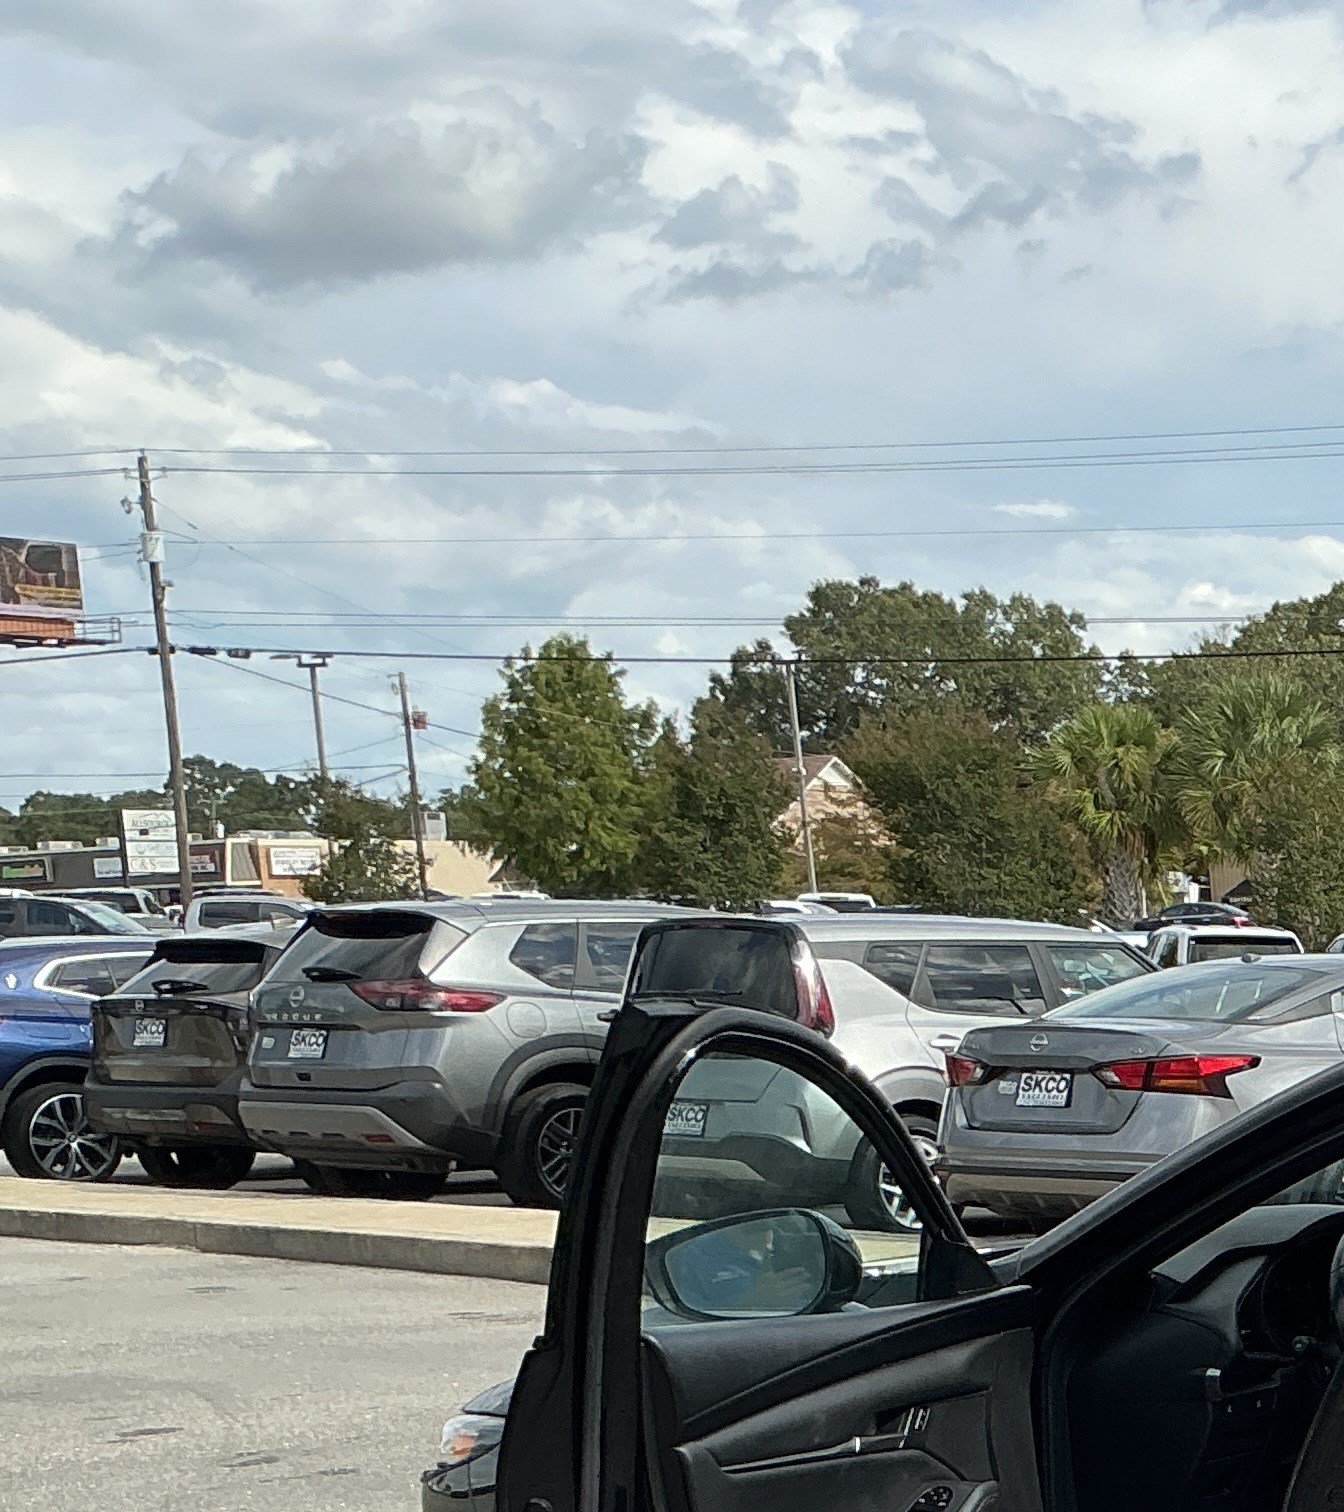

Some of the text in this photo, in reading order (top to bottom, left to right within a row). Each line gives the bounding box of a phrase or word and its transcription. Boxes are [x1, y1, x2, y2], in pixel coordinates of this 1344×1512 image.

[135, 1020, 165, 1035] SKCO
[291, 1031, 326, 1047] SKCO
[1022, 1075, 1070, 1094] SKCO
[668, 1106, 706, 1123] SKCO
